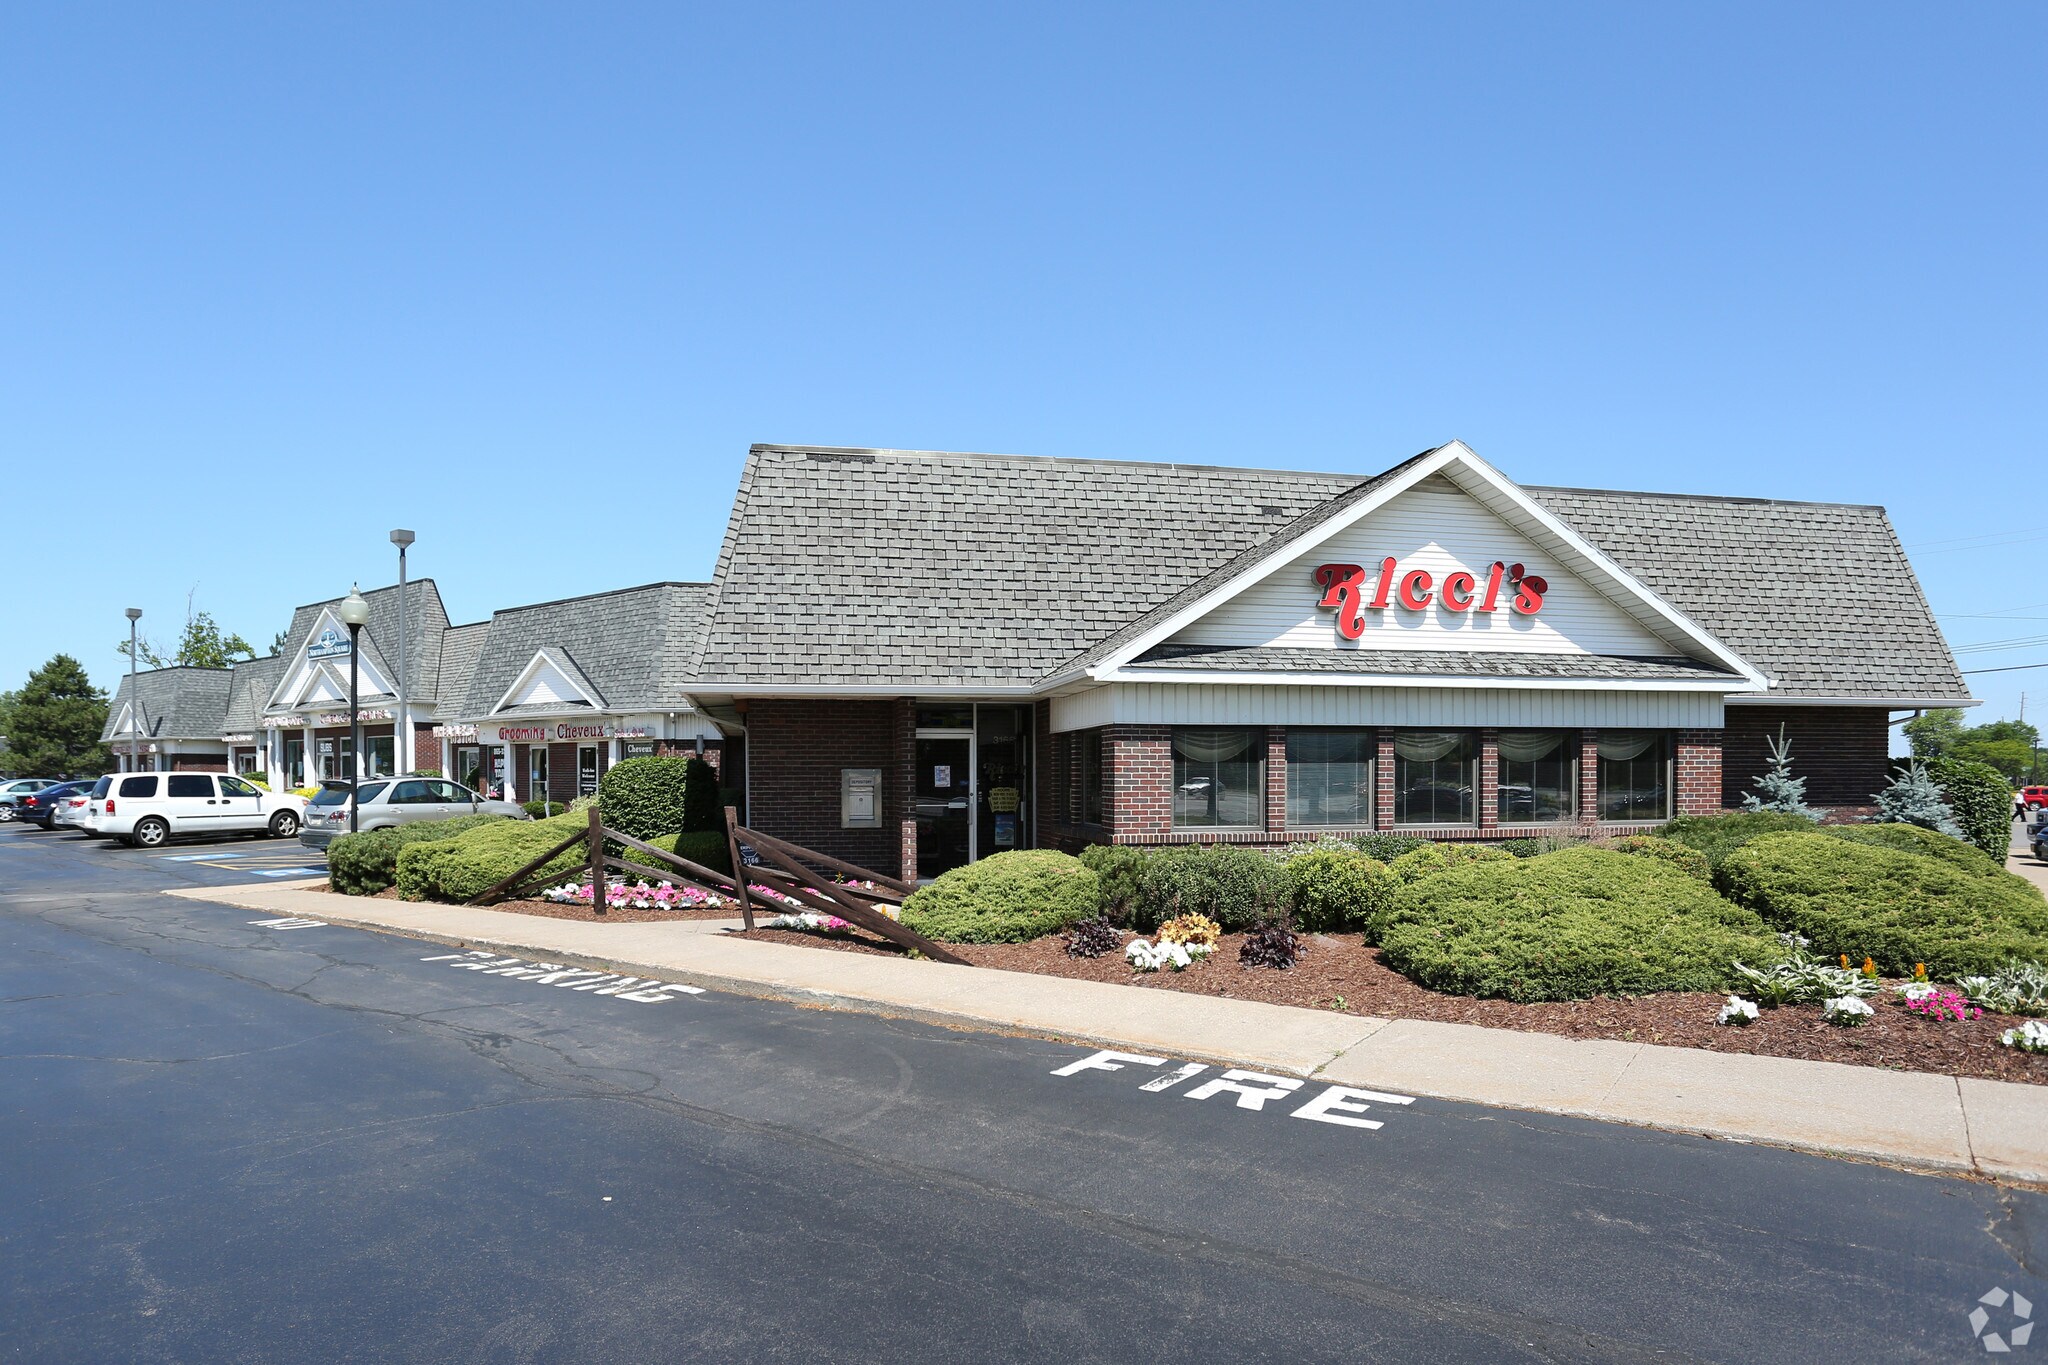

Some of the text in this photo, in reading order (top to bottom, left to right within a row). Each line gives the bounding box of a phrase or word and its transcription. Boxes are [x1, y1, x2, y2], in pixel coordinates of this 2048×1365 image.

[1311, 556, 1549, 641] Ricci's
[498, 726, 545, 741] Grooming
[614, 726, 646, 738] SALON
[420, 951, 706, 1003] PARKING
[1050, 1050, 1416, 1130] FIRE
